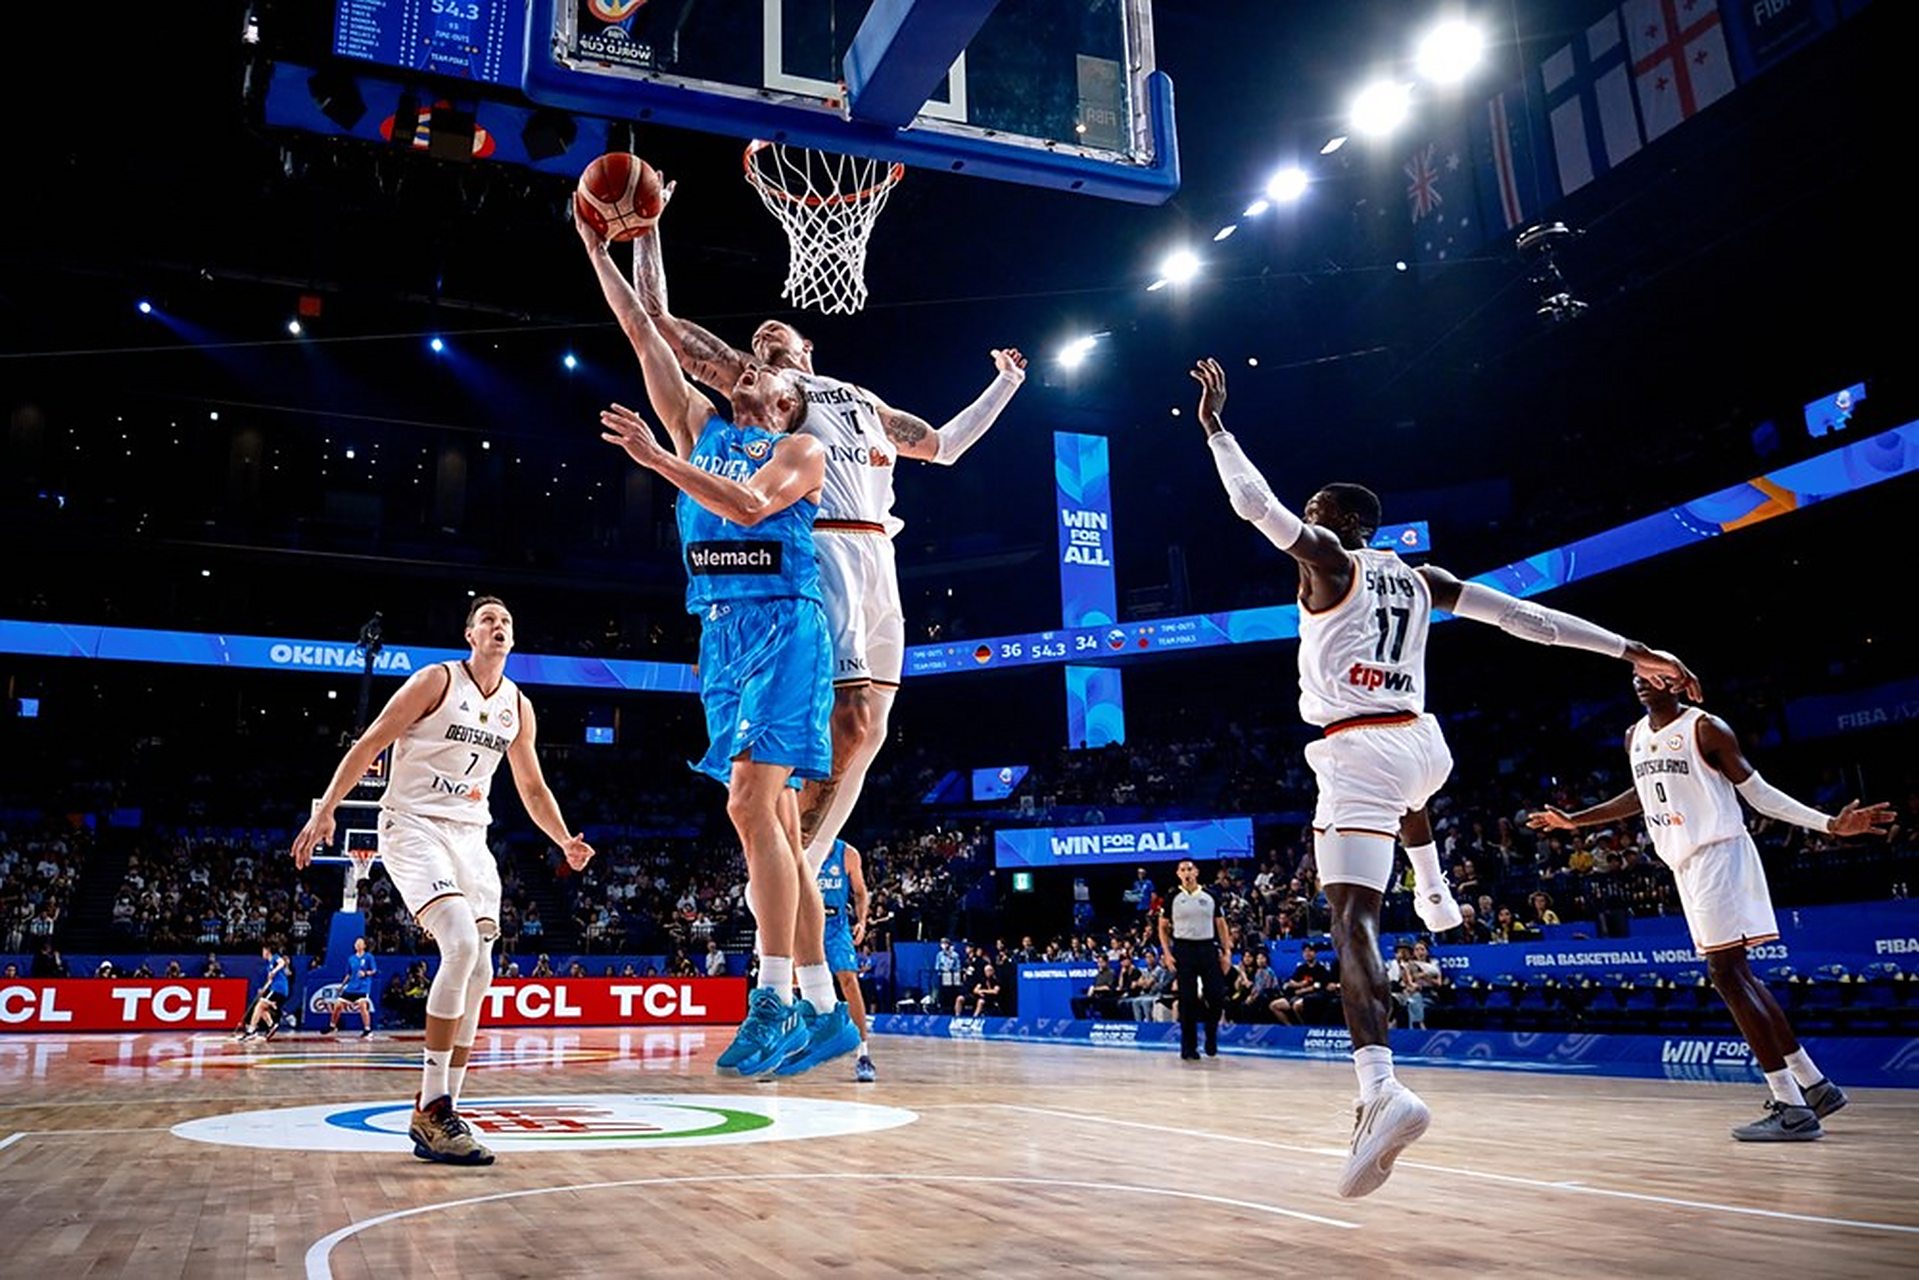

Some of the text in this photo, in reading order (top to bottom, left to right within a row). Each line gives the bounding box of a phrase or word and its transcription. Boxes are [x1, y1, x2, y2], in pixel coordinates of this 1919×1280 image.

[431, 0, 479, 20] 54.3
[829, 445, 868, 465] ING
[1062, 509, 1108, 530] WIN
[1070, 529, 1101, 542] FOR
[1064, 546, 1110, 566] ALL
[1375, 607, 1410, 663] 17
[1001, 635, 1097, 658] 36 54.3 34
[1838, 707, 1888, 730] FIBA
[464, 752, 479, 776] 7
[1655, 782, 1668, 803] 0
[1051, 831, 1189, 855] WIN FOR ALL
[1525, 954, 1555, 966] FIBA
[1557, 951, 1647, 965] BASKETBALL
[1746, 946, 1788, 960] 2023
[1876, 938, 1919, 954] FIBA
[1441, 957, 1469, 968] 2023
[112, 986, 227, 1022] TCL
[486, 984, 582, 1018] TCL
[610, 984, 706, 1017] TCL
[1661, 1040, 1750, 1064] WIN FOR
